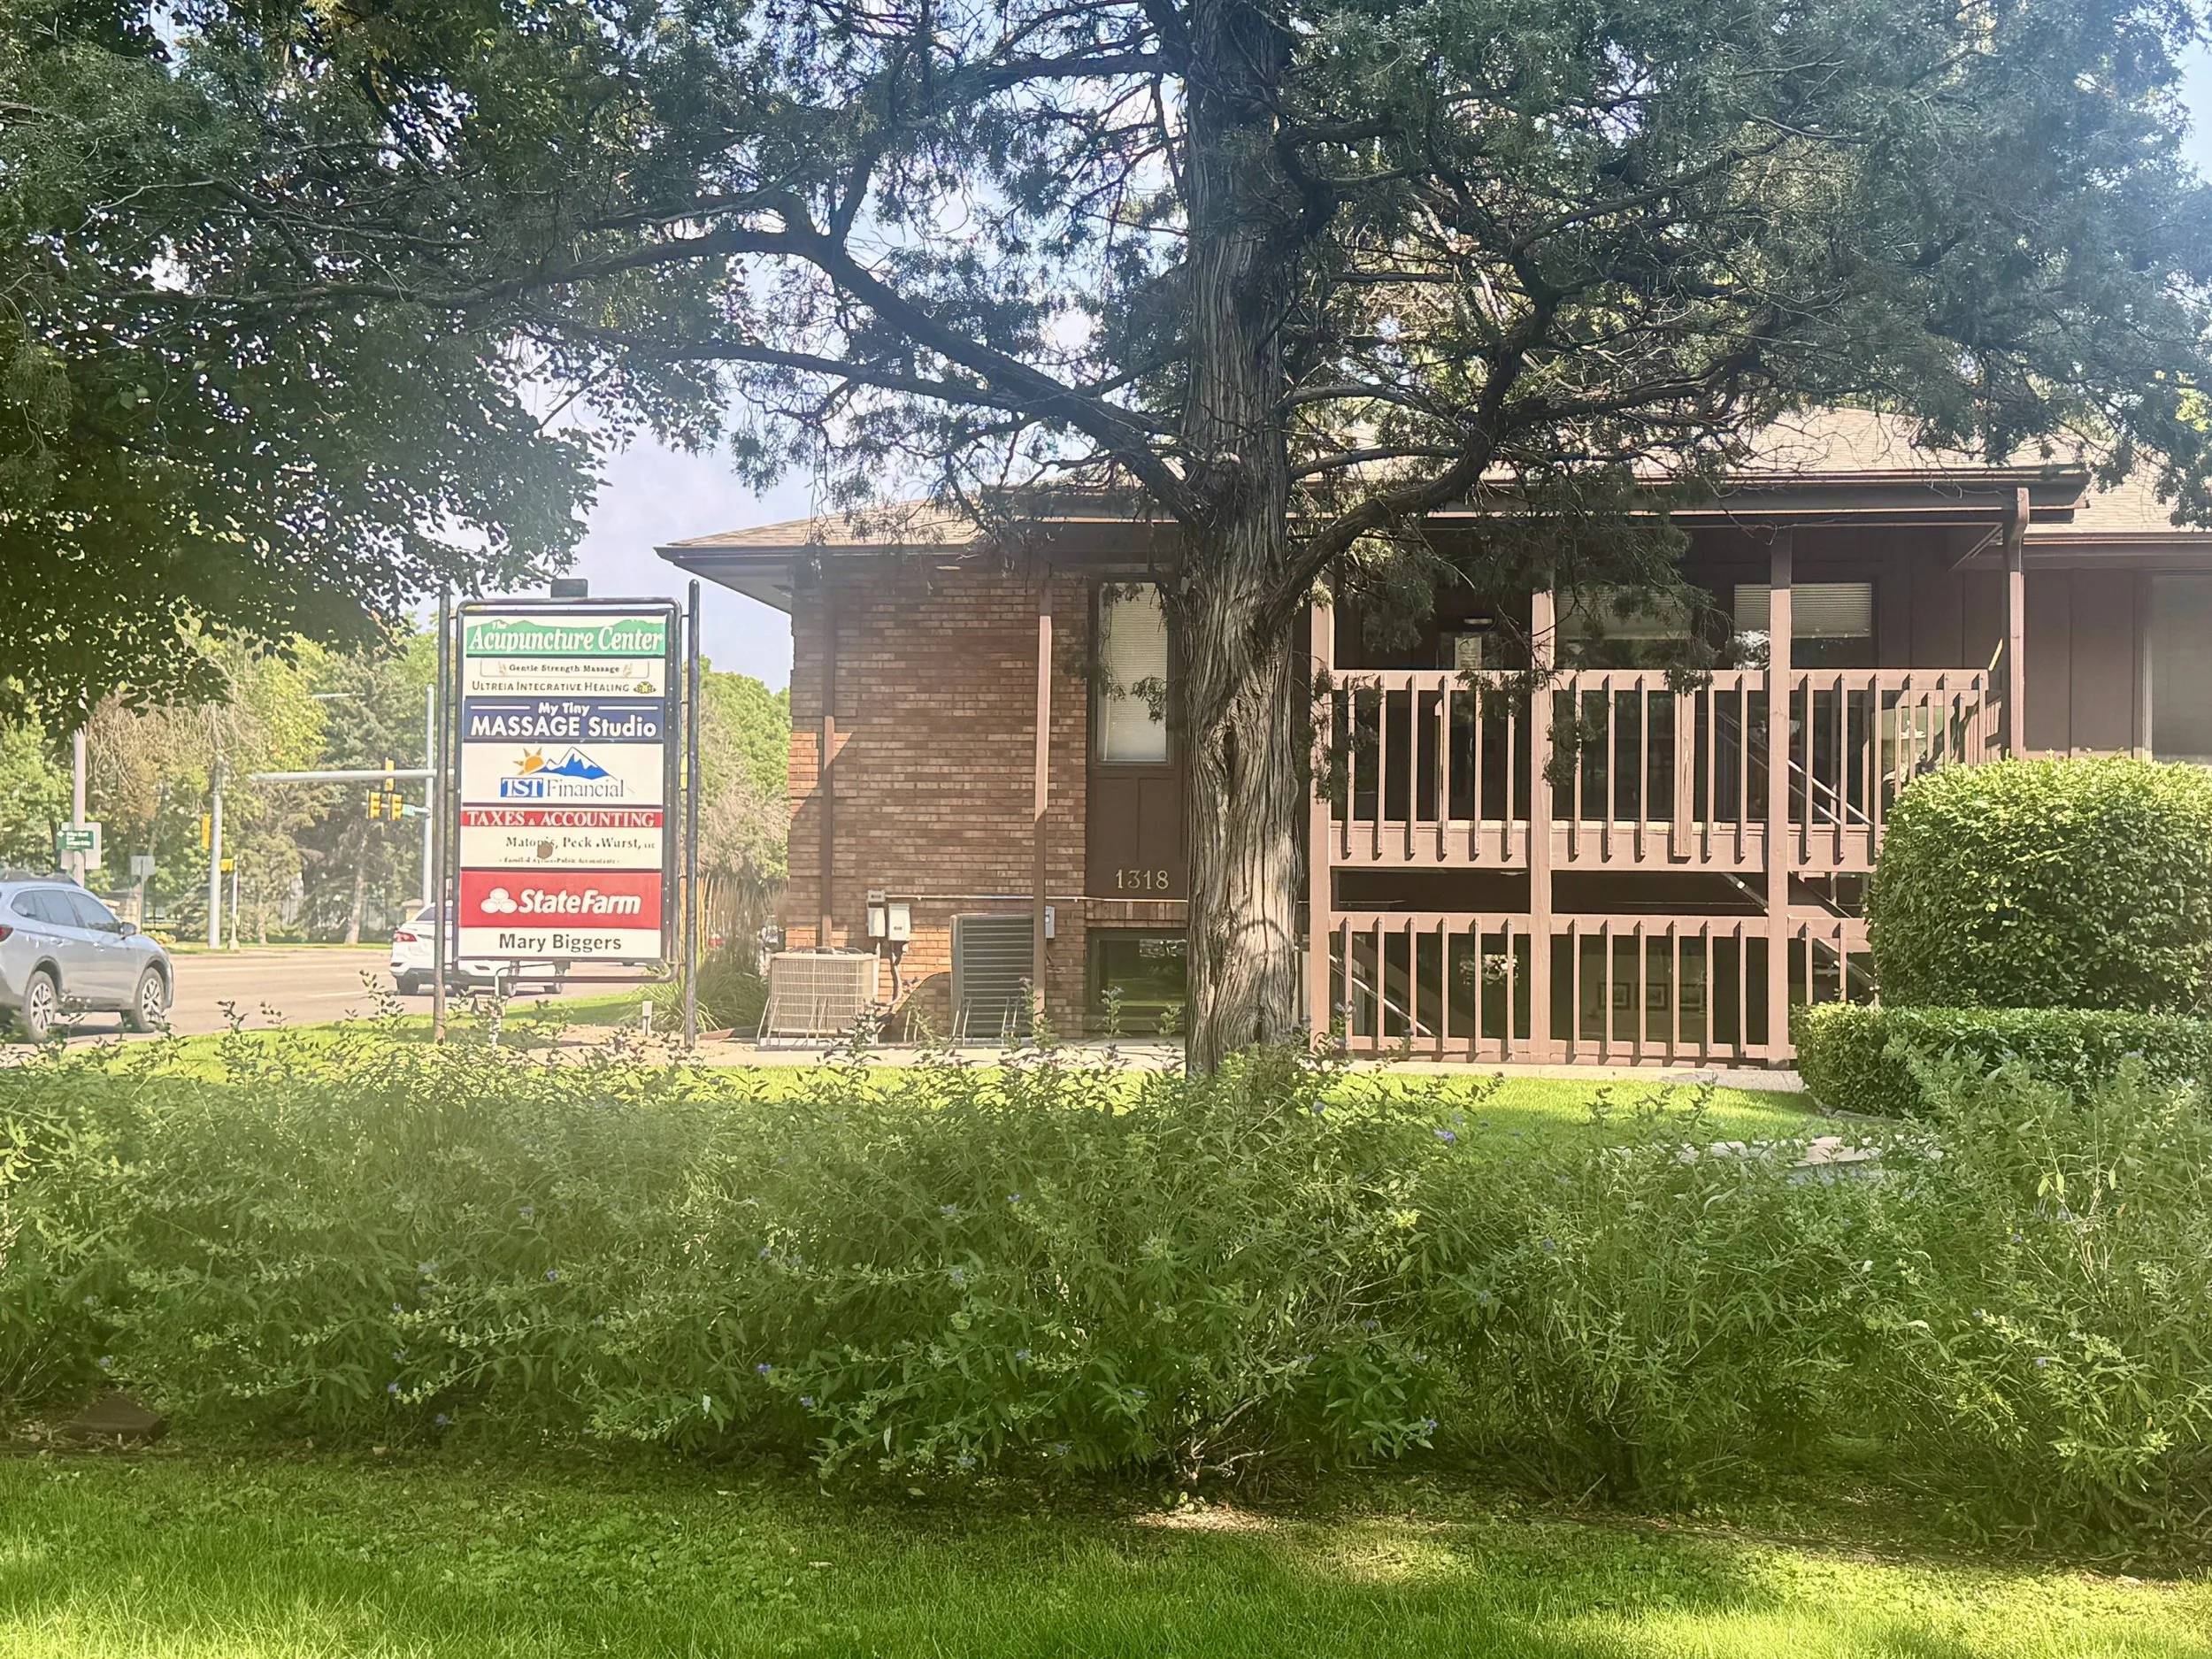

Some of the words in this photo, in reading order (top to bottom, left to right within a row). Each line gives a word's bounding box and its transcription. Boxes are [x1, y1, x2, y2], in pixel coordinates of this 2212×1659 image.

[468, 625, 595, 653] Acupuncture
[598, 626, 664, 650] Center
[541, 664, 580, 673] Strength
[584, 681, 630, 692] HEALING
[538, 702, 559, 716] My
[562, 702, 590, 717] Tiny
[471, 715, 580, 736] MASSAGE
[588, 714, 657, 737] Studio
[547, 779, 625, 797] Financial
[467, 810, 526, 826] TAXES
[541, 811, 655, 827] ACCOUNTING
[563, 836, 592, 848] Peck
[1115, 869, 1169, 889] 1318
[499, 933, 546, 952] Mary
[553, 933, 622, 953] Biggers
